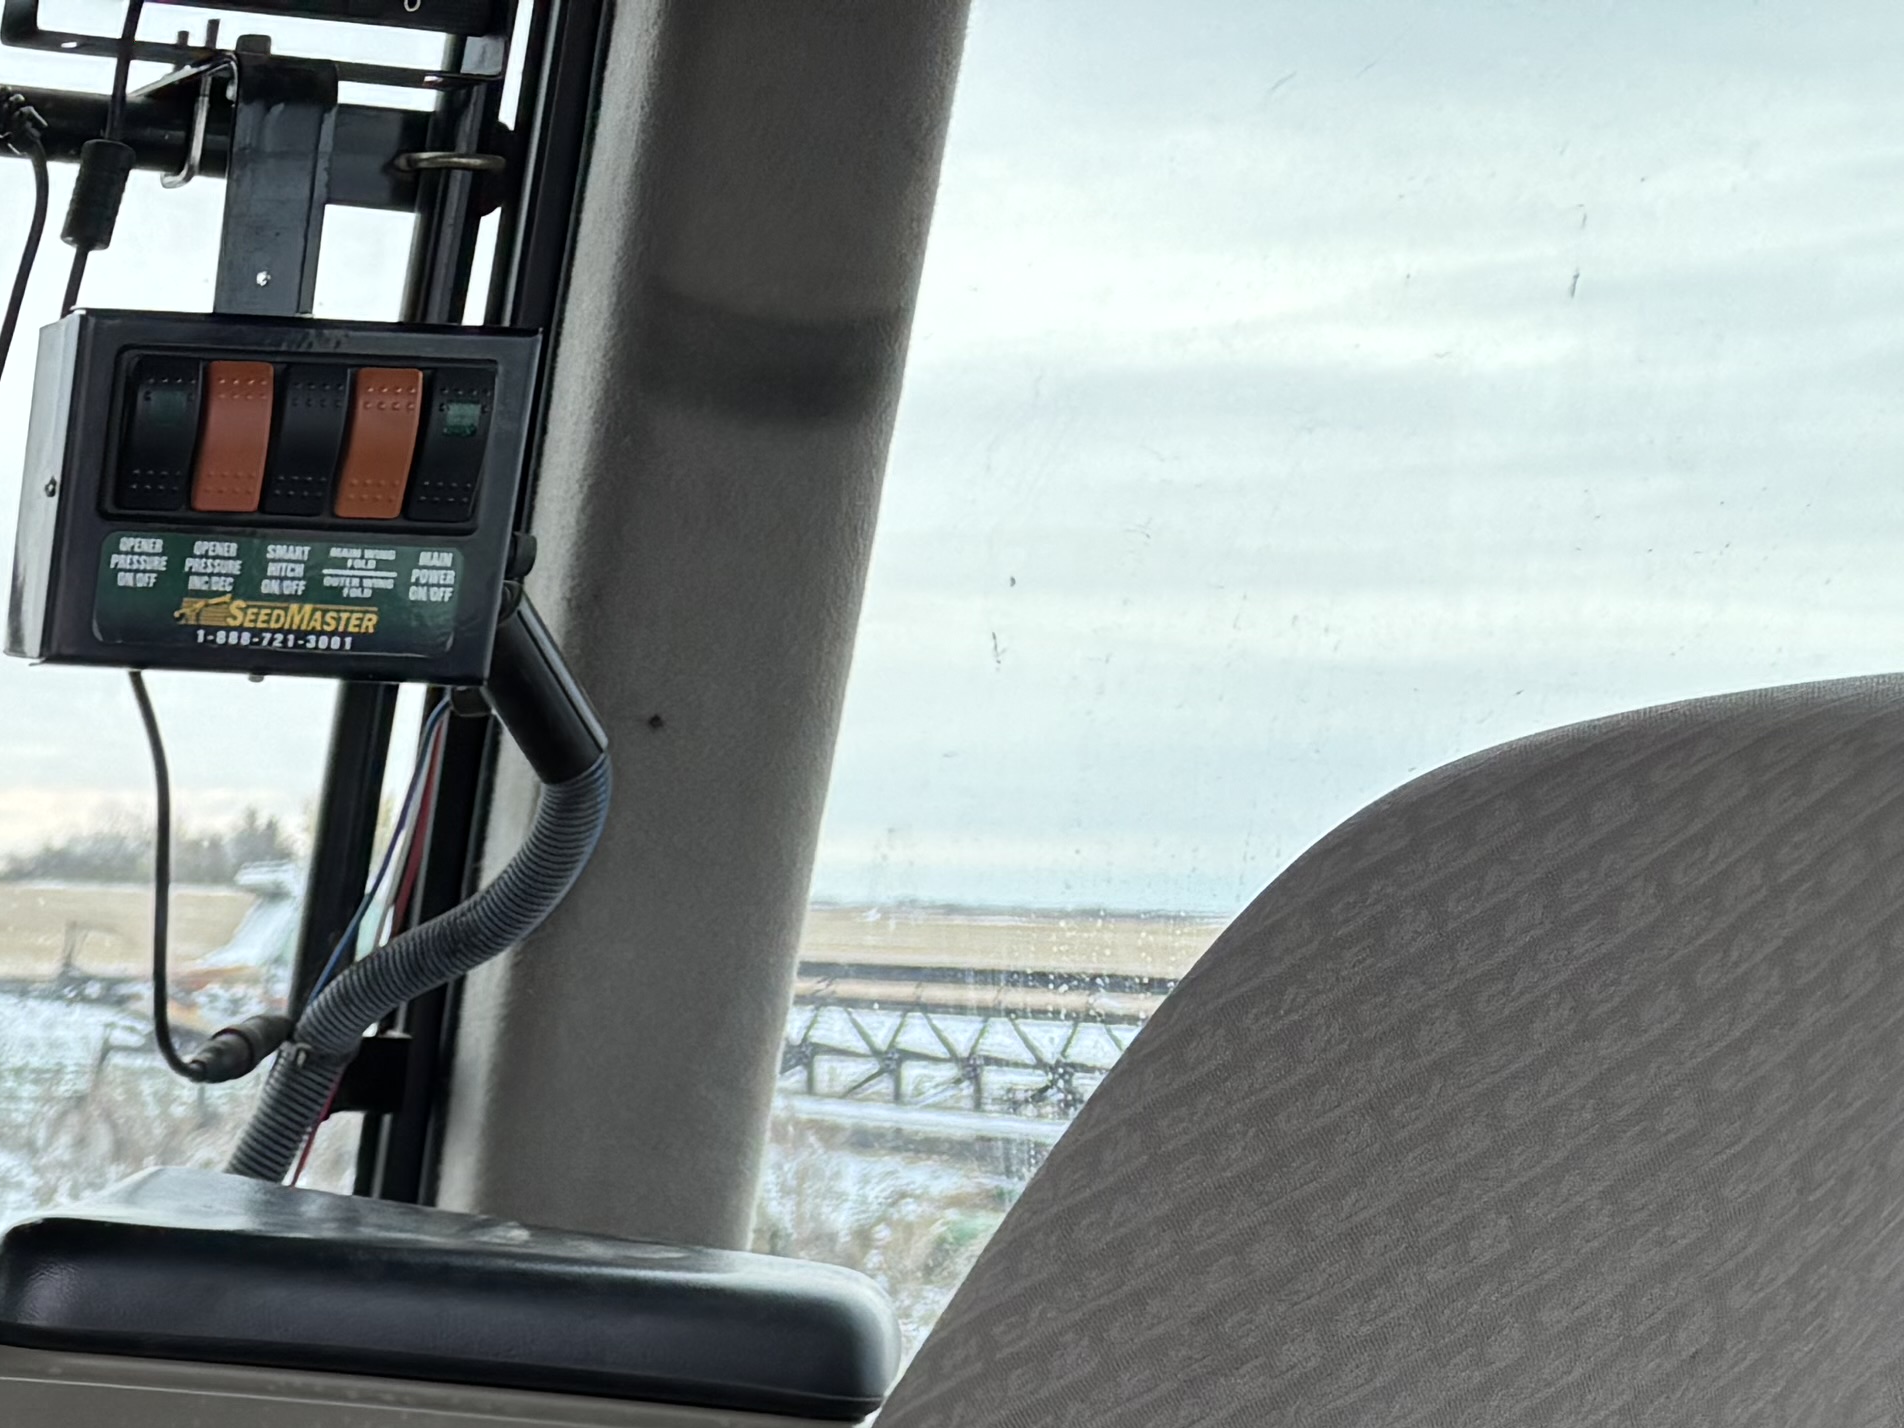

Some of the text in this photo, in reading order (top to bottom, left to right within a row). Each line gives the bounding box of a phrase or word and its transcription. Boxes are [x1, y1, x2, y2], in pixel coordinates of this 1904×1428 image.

[119, 537, 163, 553] OPENER
[194, 541, 237, 557] OPENER
[266, 545, 311, 561] SMART
[110, 554, 168, 571] PRESSURE
[184, 557, 242, 574] PRESSURE
[419, 551, 453, 567] MAIN
[267, 562, 304, 578] HITCH
[411, 569, 455, 585] POWER
[323, 576, 361, 587] OUTER
